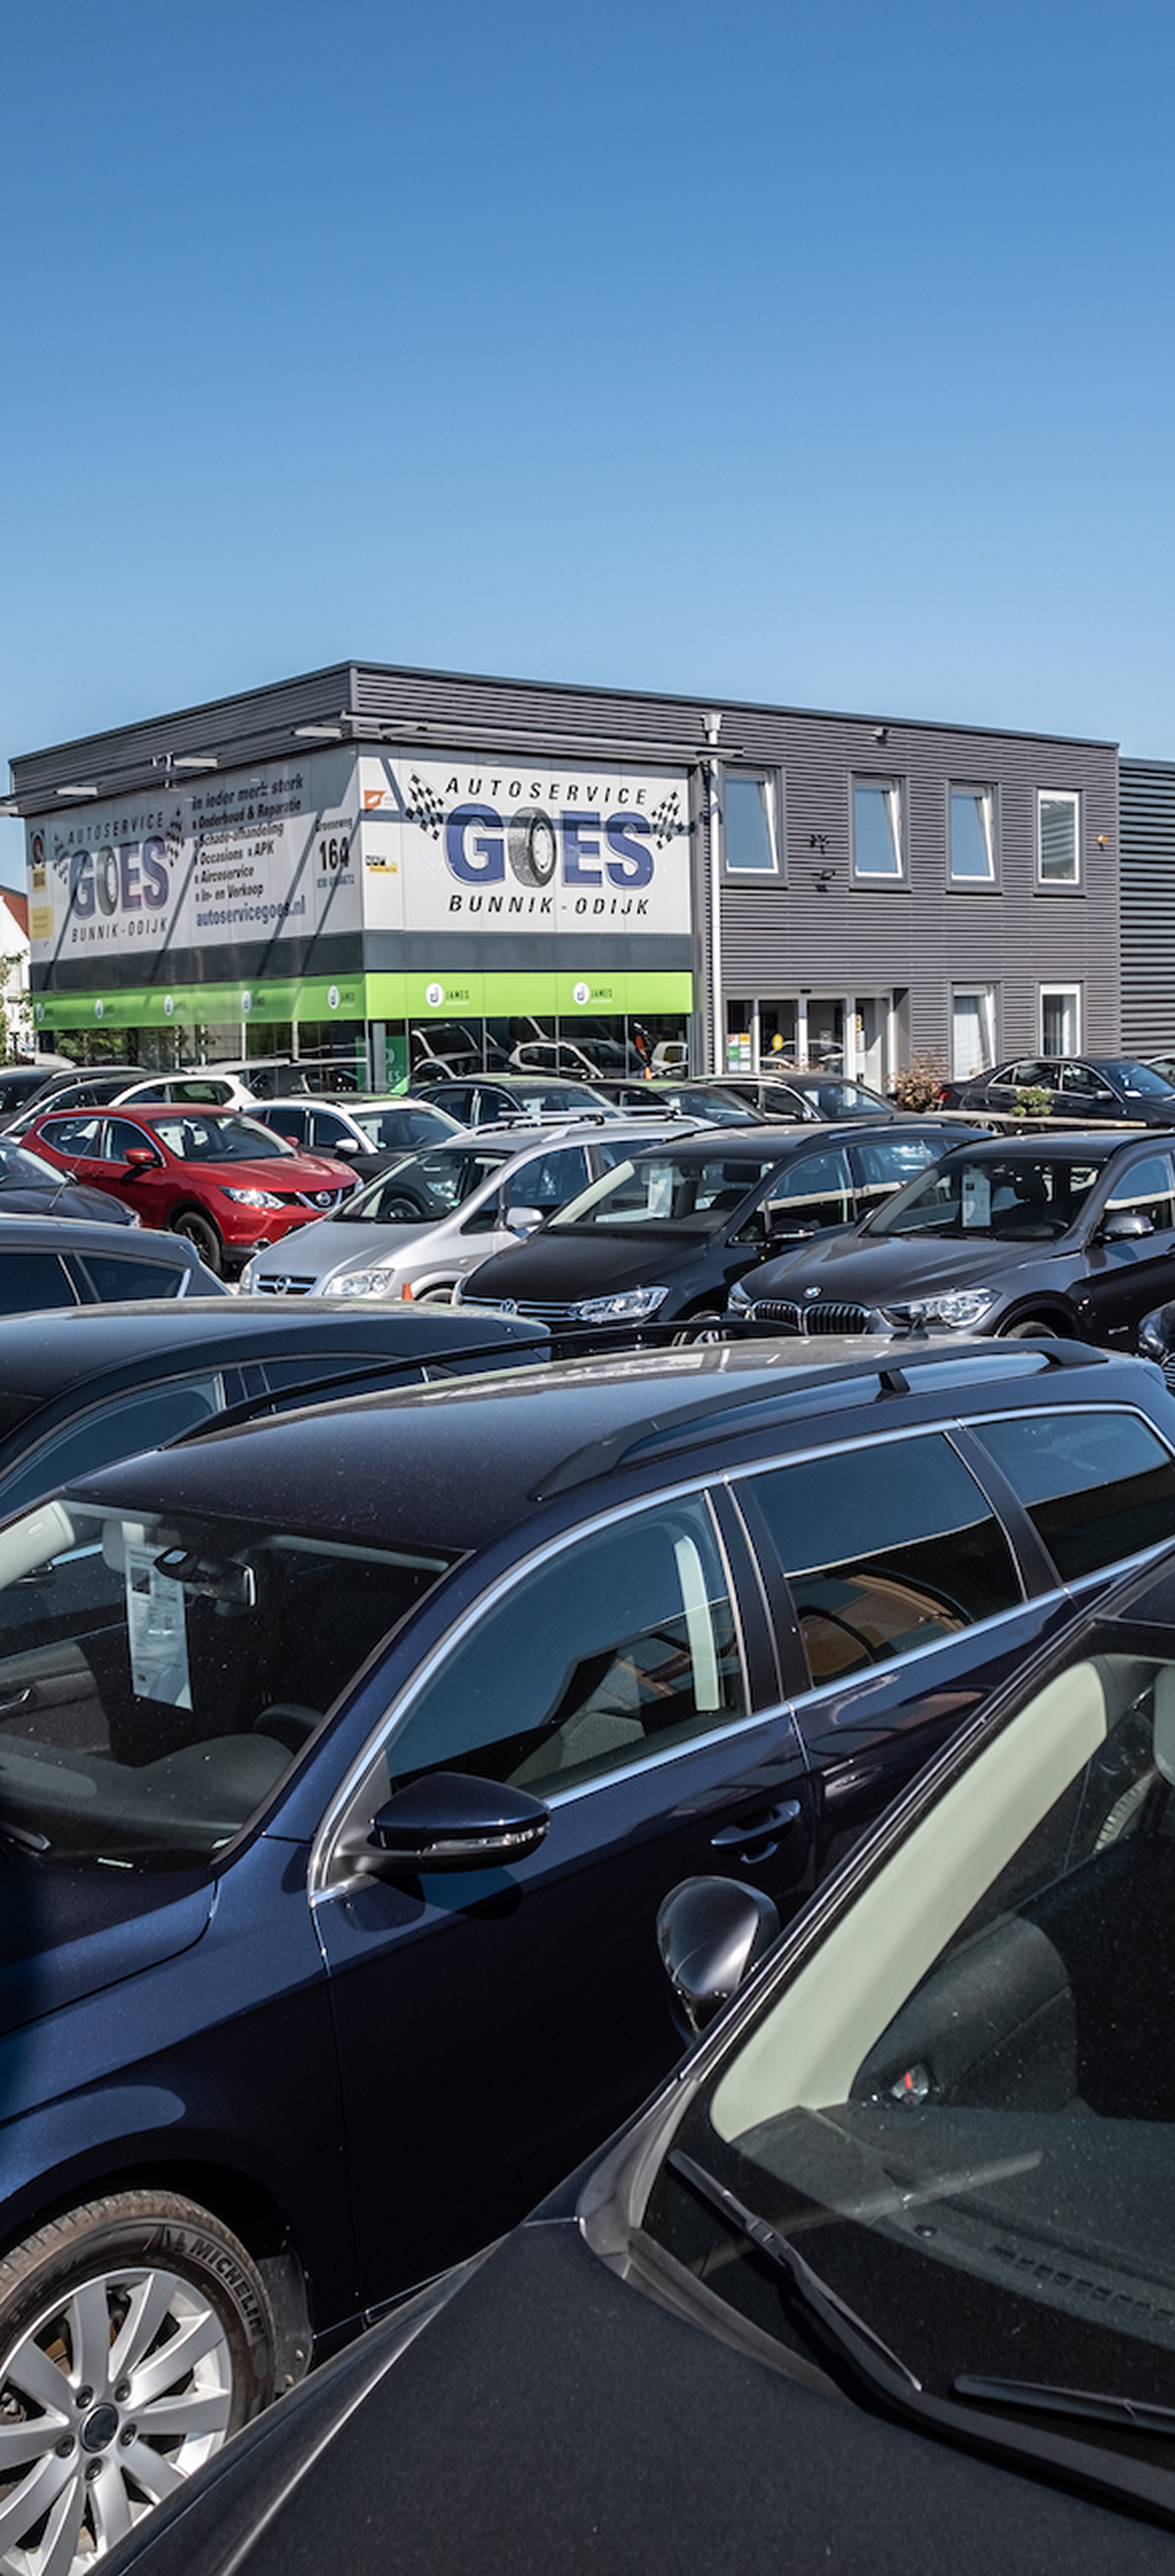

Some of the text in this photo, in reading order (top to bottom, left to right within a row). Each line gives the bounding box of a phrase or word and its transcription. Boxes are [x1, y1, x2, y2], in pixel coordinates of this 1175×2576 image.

[192, 796, 202, 810] in
[206, 790, 234, 808] ieder
[445, 777, 647, 805] AUTOSERVICE
[68, 812, 164, 845] AUTOSERVICE
[199, 797, 301, 829] Onderhoud & Reparatie
[200, 841, 274, 865] Occasions APK
[319, 837, 349, 870] 164
[445, 803, 654, 891] GOES
[69, 835, 169, 920] GOES
[227, 883, 263, 898] Verkoop
[197, 894, 305, 926] autoservicegoes.nl
[190, 2238, 265, 2336] MICHELIN
